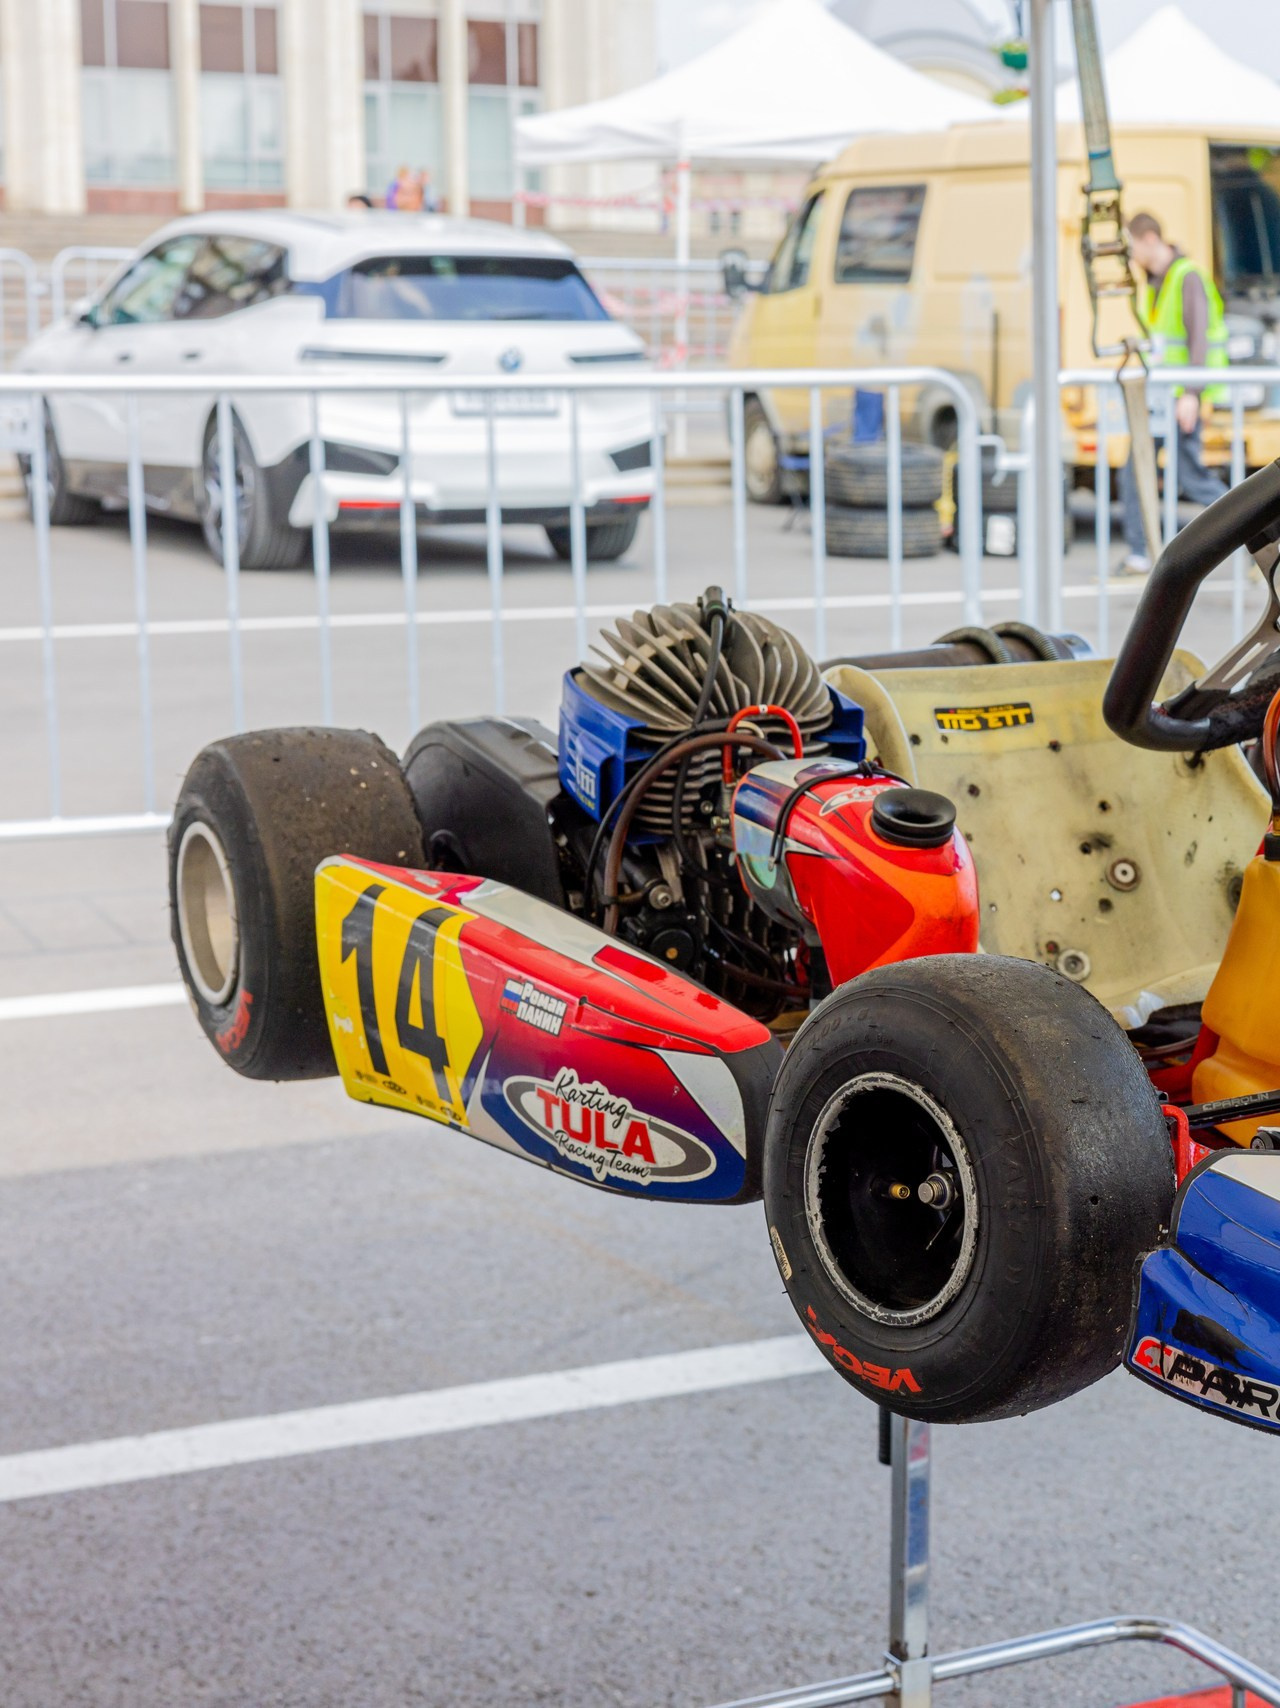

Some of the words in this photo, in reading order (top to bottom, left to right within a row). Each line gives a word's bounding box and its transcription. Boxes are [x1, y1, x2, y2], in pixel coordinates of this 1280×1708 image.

[341, 884, 457, 1103] 14
[536, 1087, 656, 1164] TULA
[555, 1073, 629, 1129] Karting
[554, 1130, 605, 1173] Racing
[605, 1149, 650, 1178] Team
